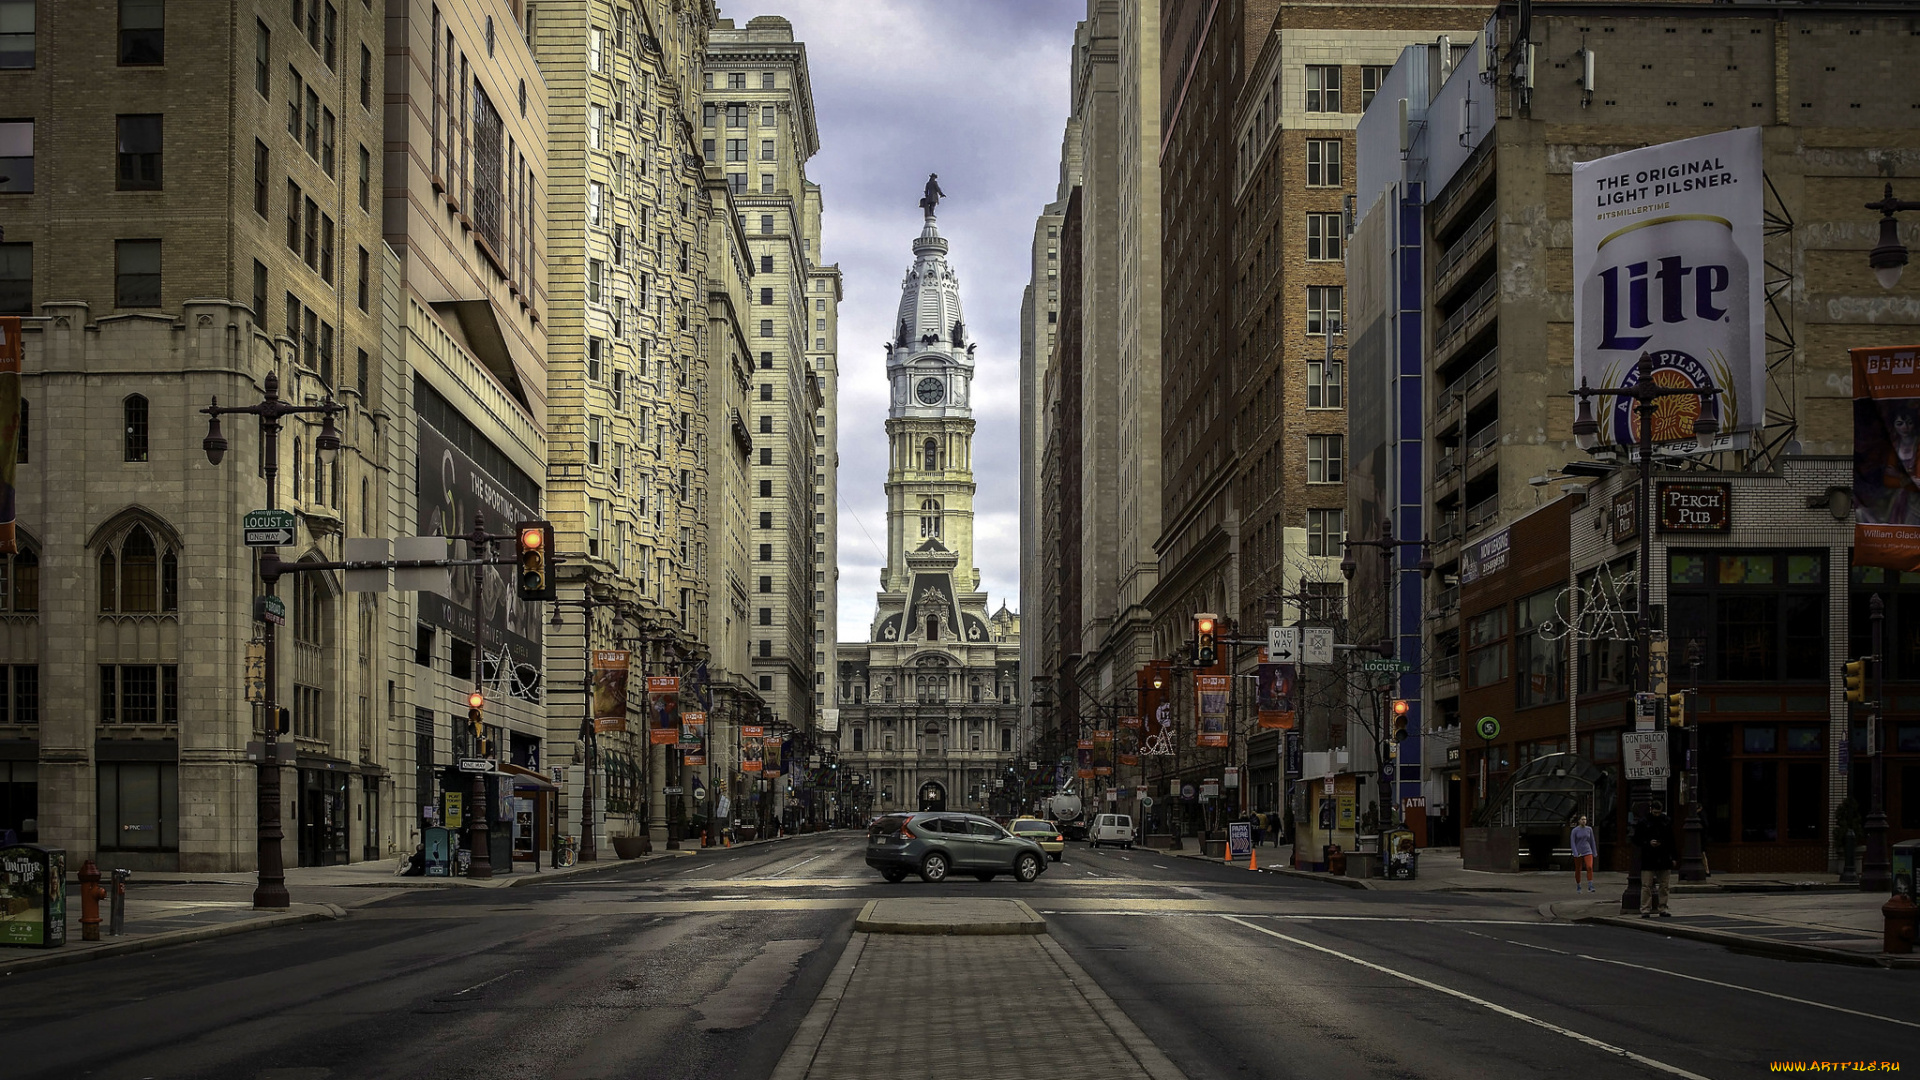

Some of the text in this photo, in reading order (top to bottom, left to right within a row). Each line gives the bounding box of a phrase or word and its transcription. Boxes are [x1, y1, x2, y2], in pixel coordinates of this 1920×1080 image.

[1597, 158, 1724, 191] THE ORIGINAL
[1597, 173, 1738, 207] LIGHT PILSNER.
[1597, 202, 1670, 220] #ITSMILLERTIME
[1597, 256, 1729, 350] Lite
[470, 471, 484, 500] THE
[485, 483, 514, 523] SPORTING
[1670, 491, 1720, 523] PERCH PUB
[245, 517, 293, 527] LOCUST ST
[249, 532, 280, 541] ONE WAY
[1863, 530, 1893, 538] William
[458, 611, 476, 634] HAVE
[1274, 630, 1293, 638] ONE
[1274, 639, 1293, 648] WAY
[1364, 663, 1400, 672] LOCUST
[1644, 733, 1666, 743] BLOCK
[1629, 767, 1645, 777] THE
[1406, 798, 1425, 807] ATM
[5, 862, 40, 874] UNLITTER
